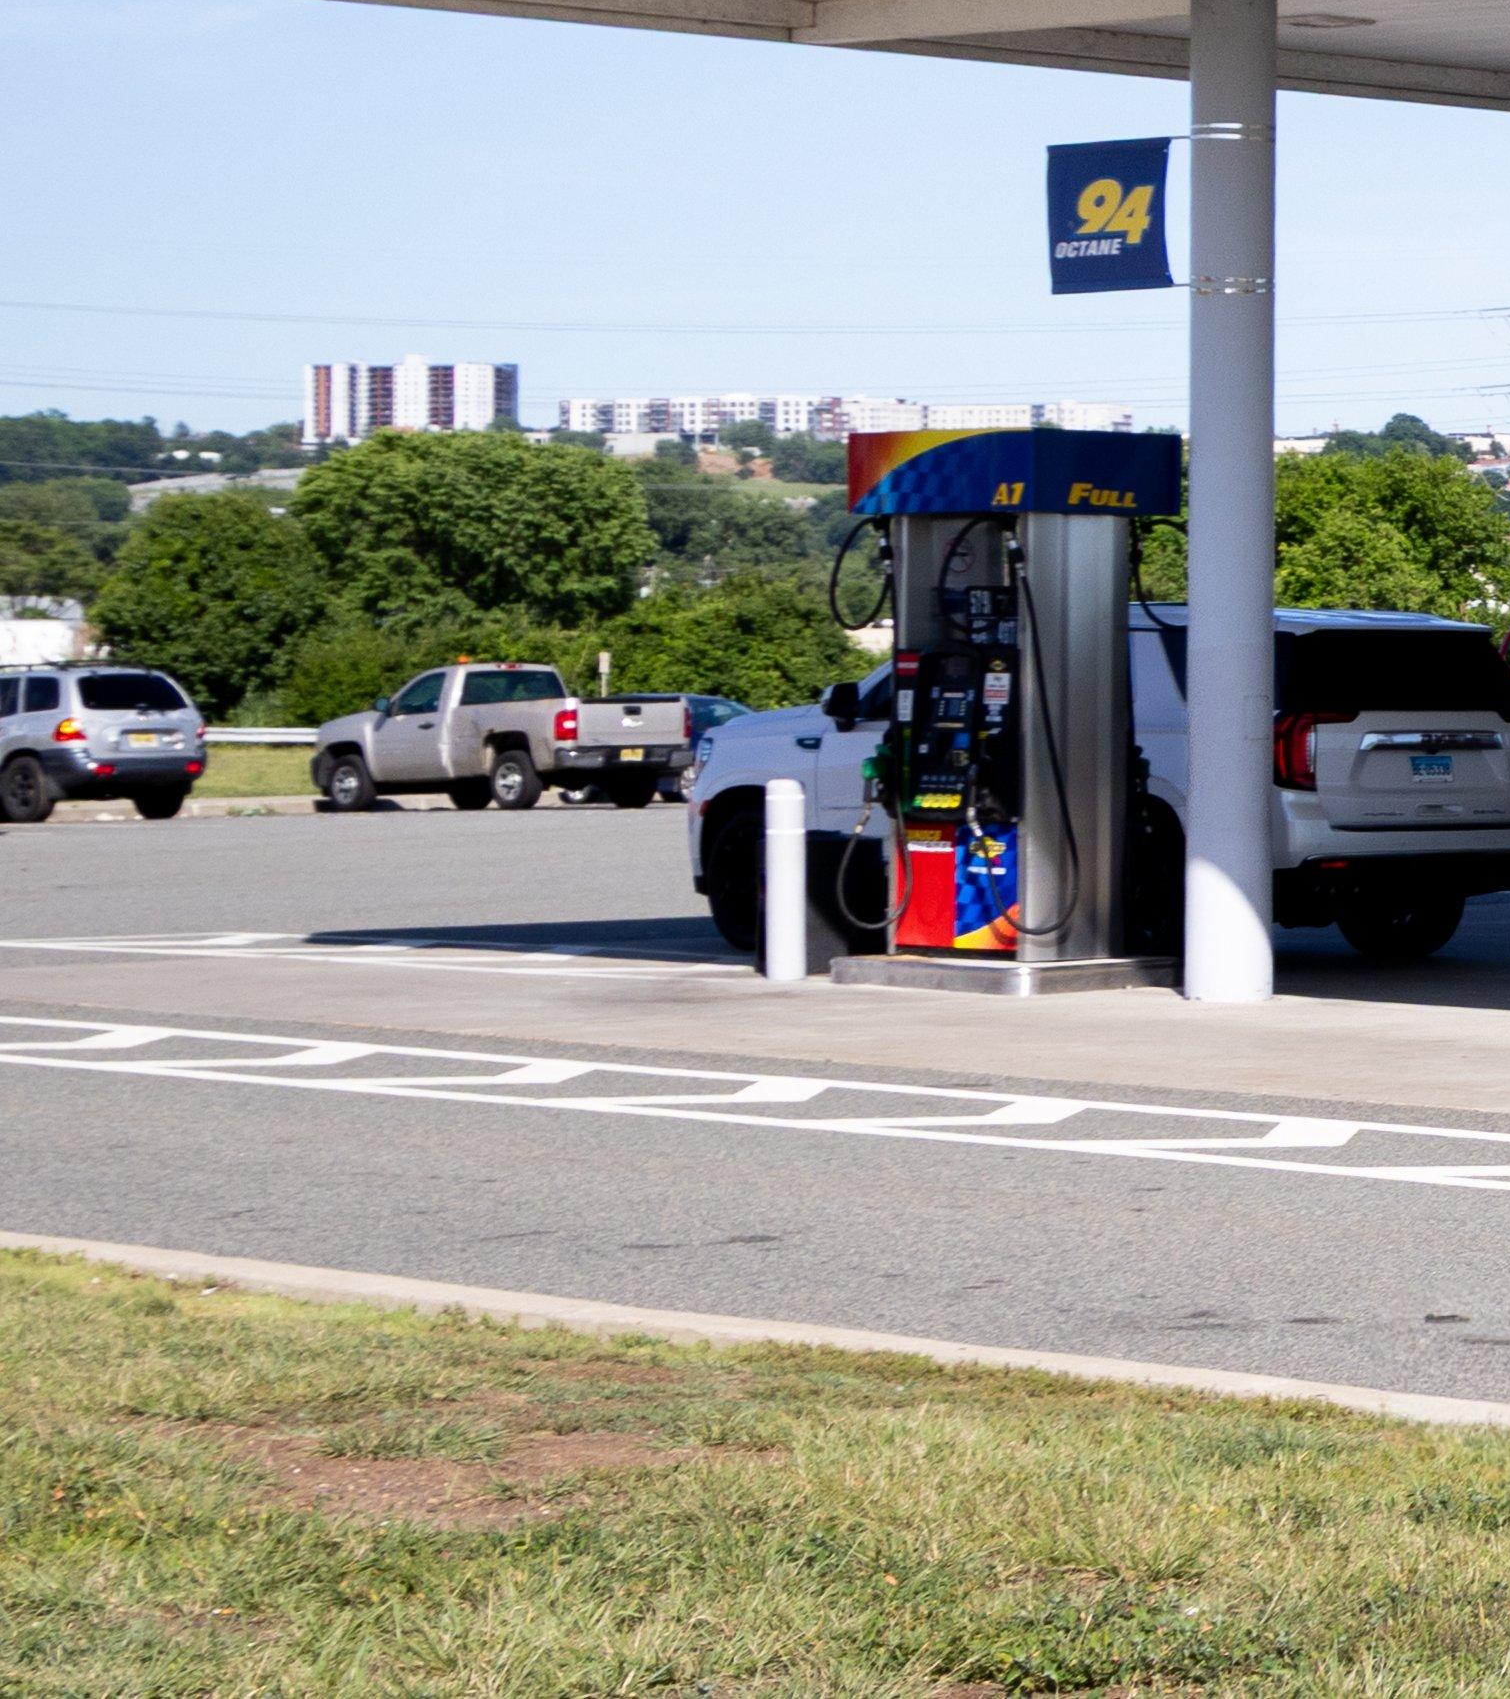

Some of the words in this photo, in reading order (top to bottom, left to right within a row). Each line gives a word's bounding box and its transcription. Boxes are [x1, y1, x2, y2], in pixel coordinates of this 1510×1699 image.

[1074, 178, 1154, 244] 94
[1054, 238, 1122, 258] OCTANE
[992, 482, 1026, 506] A1
